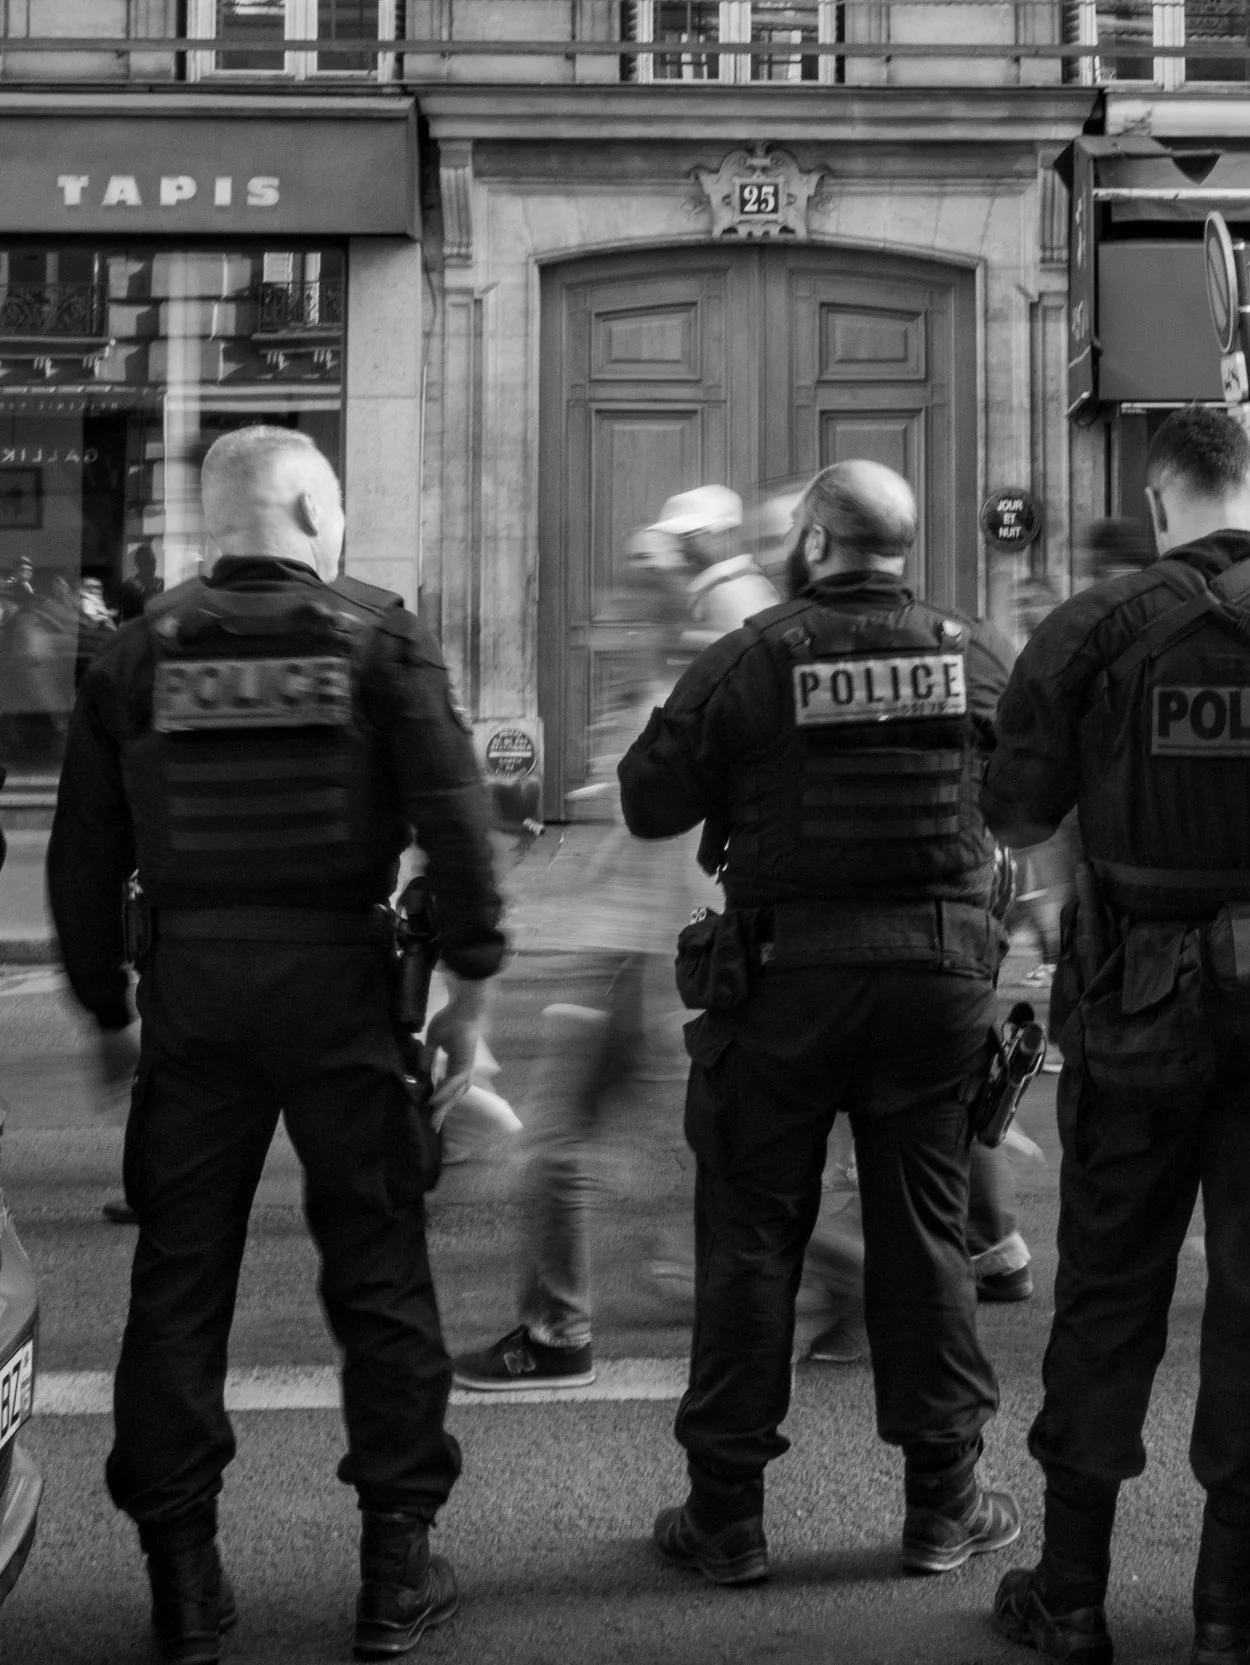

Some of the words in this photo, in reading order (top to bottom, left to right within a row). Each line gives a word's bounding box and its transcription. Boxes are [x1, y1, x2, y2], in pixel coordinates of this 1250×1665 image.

[57, 175, 282, 208] TAPIS
[743, 185, 776, 213] 25
[997, 499, 1024, 512] JOUR
[1003, 512, 1017, 525] ET
[998, 526, 1022, 539] NUIT
[158, 664, 347, 709] POLICE
[799, 664, 961, 708] POLICE
